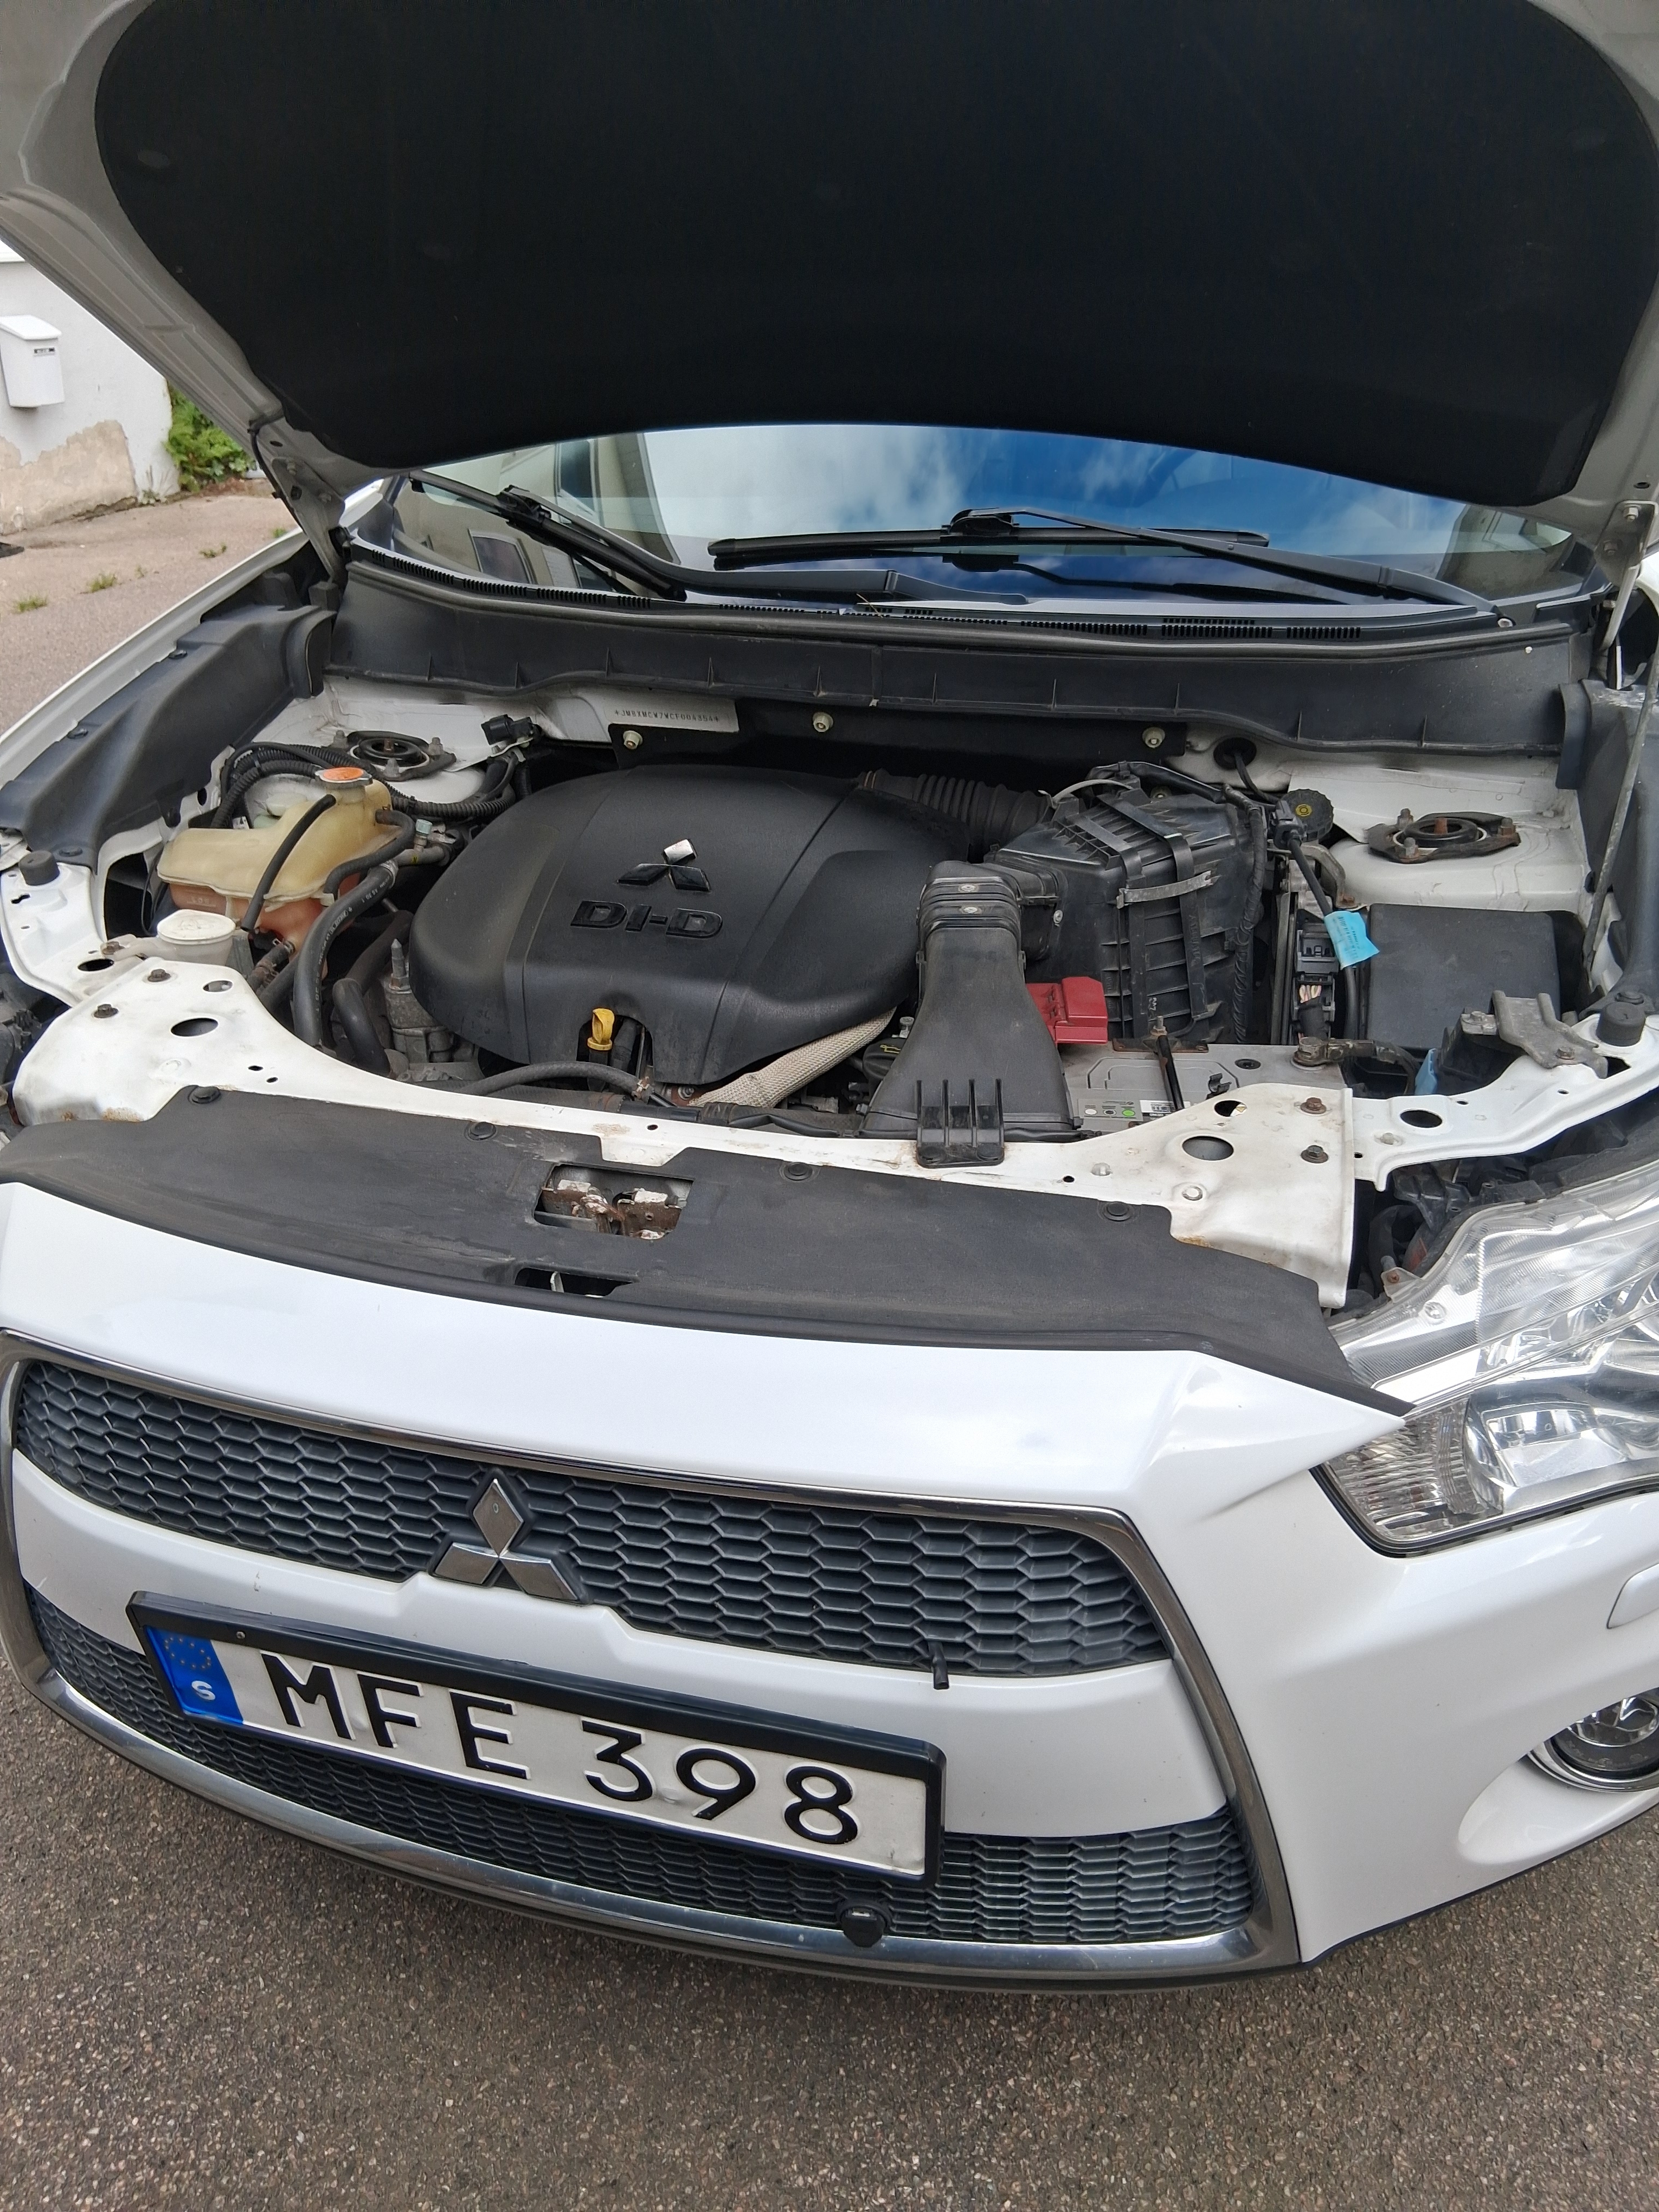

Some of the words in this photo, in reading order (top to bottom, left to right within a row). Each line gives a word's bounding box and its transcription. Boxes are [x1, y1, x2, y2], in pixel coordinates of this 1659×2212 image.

[570, 900, 723, 938] DI-D
[191, 1680, 216, 1702] S
[260, 1651, 531, 1780] MFE
[581, 1717, 860, 1844] 398
